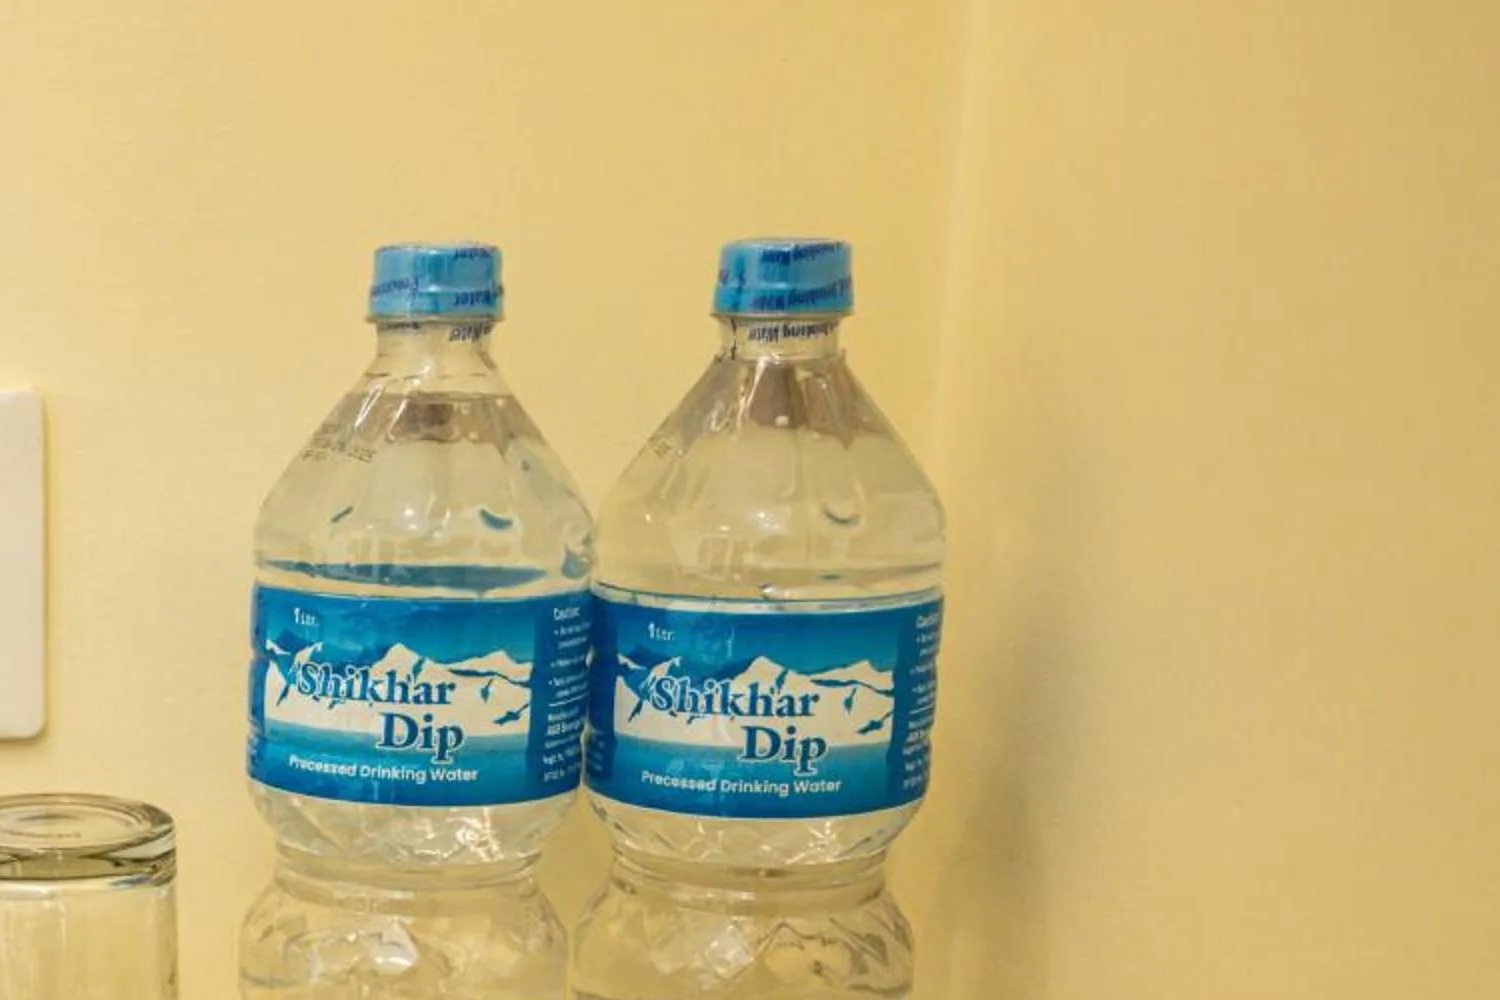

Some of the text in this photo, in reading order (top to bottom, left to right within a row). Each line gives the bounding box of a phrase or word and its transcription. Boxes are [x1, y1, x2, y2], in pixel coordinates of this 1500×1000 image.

[296, 661, 457, 705] Shikhar
[651, 676, 820, 717] Shikhar
[377, 711, 465, 763] Dip
[739, 724, 828, 776] Dip
[289, 755, 479, 785] Processed Drinking Water
[720, 778, 789, 797] Drinking
[793, 780, 842, 794] Water
